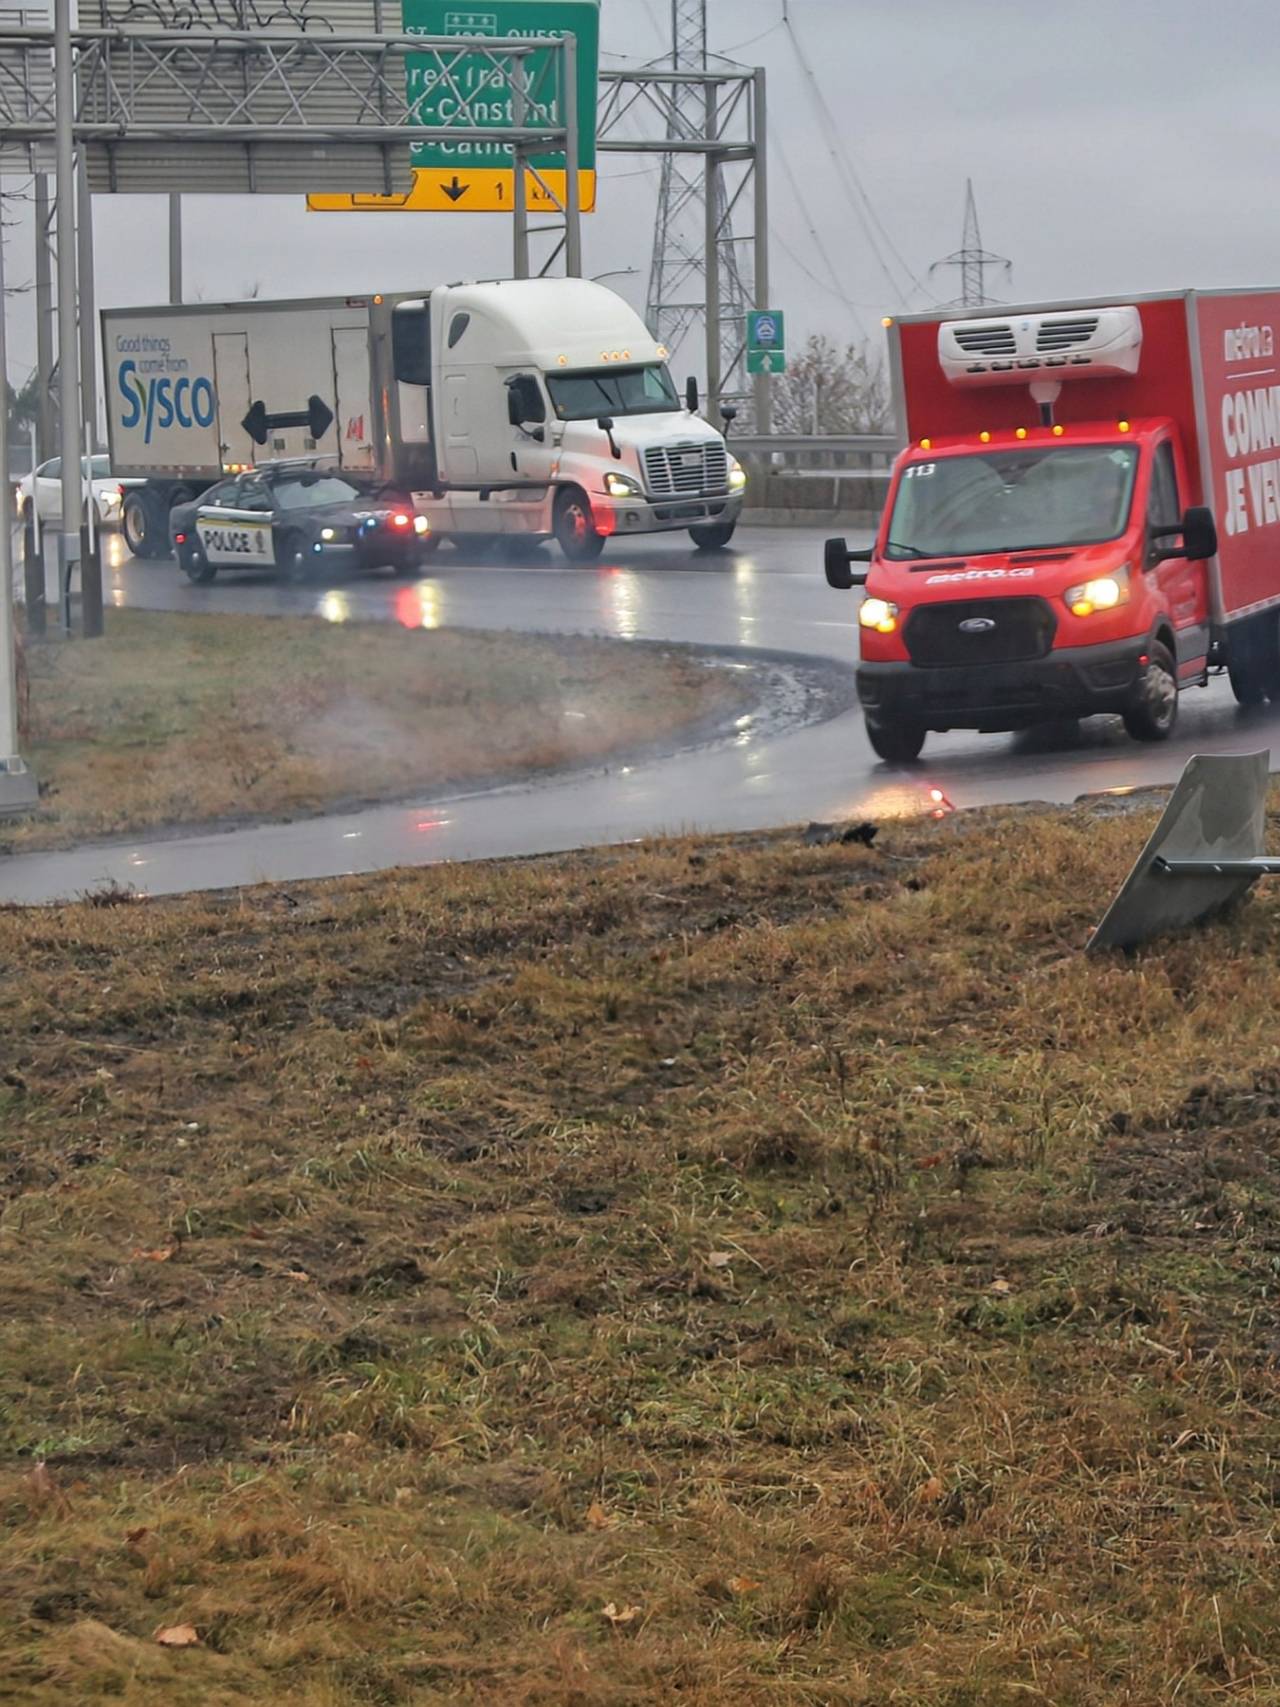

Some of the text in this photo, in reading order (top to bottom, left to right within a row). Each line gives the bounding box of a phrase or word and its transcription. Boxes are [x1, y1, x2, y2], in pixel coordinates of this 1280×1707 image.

[495, 182, 503, 200] 1
[116, 335, 140, 353] Good
[905, 463, 935, 478] 113
[1225, 468, 1248, 536] JE
[203, 529, 251, 553] POLICE
